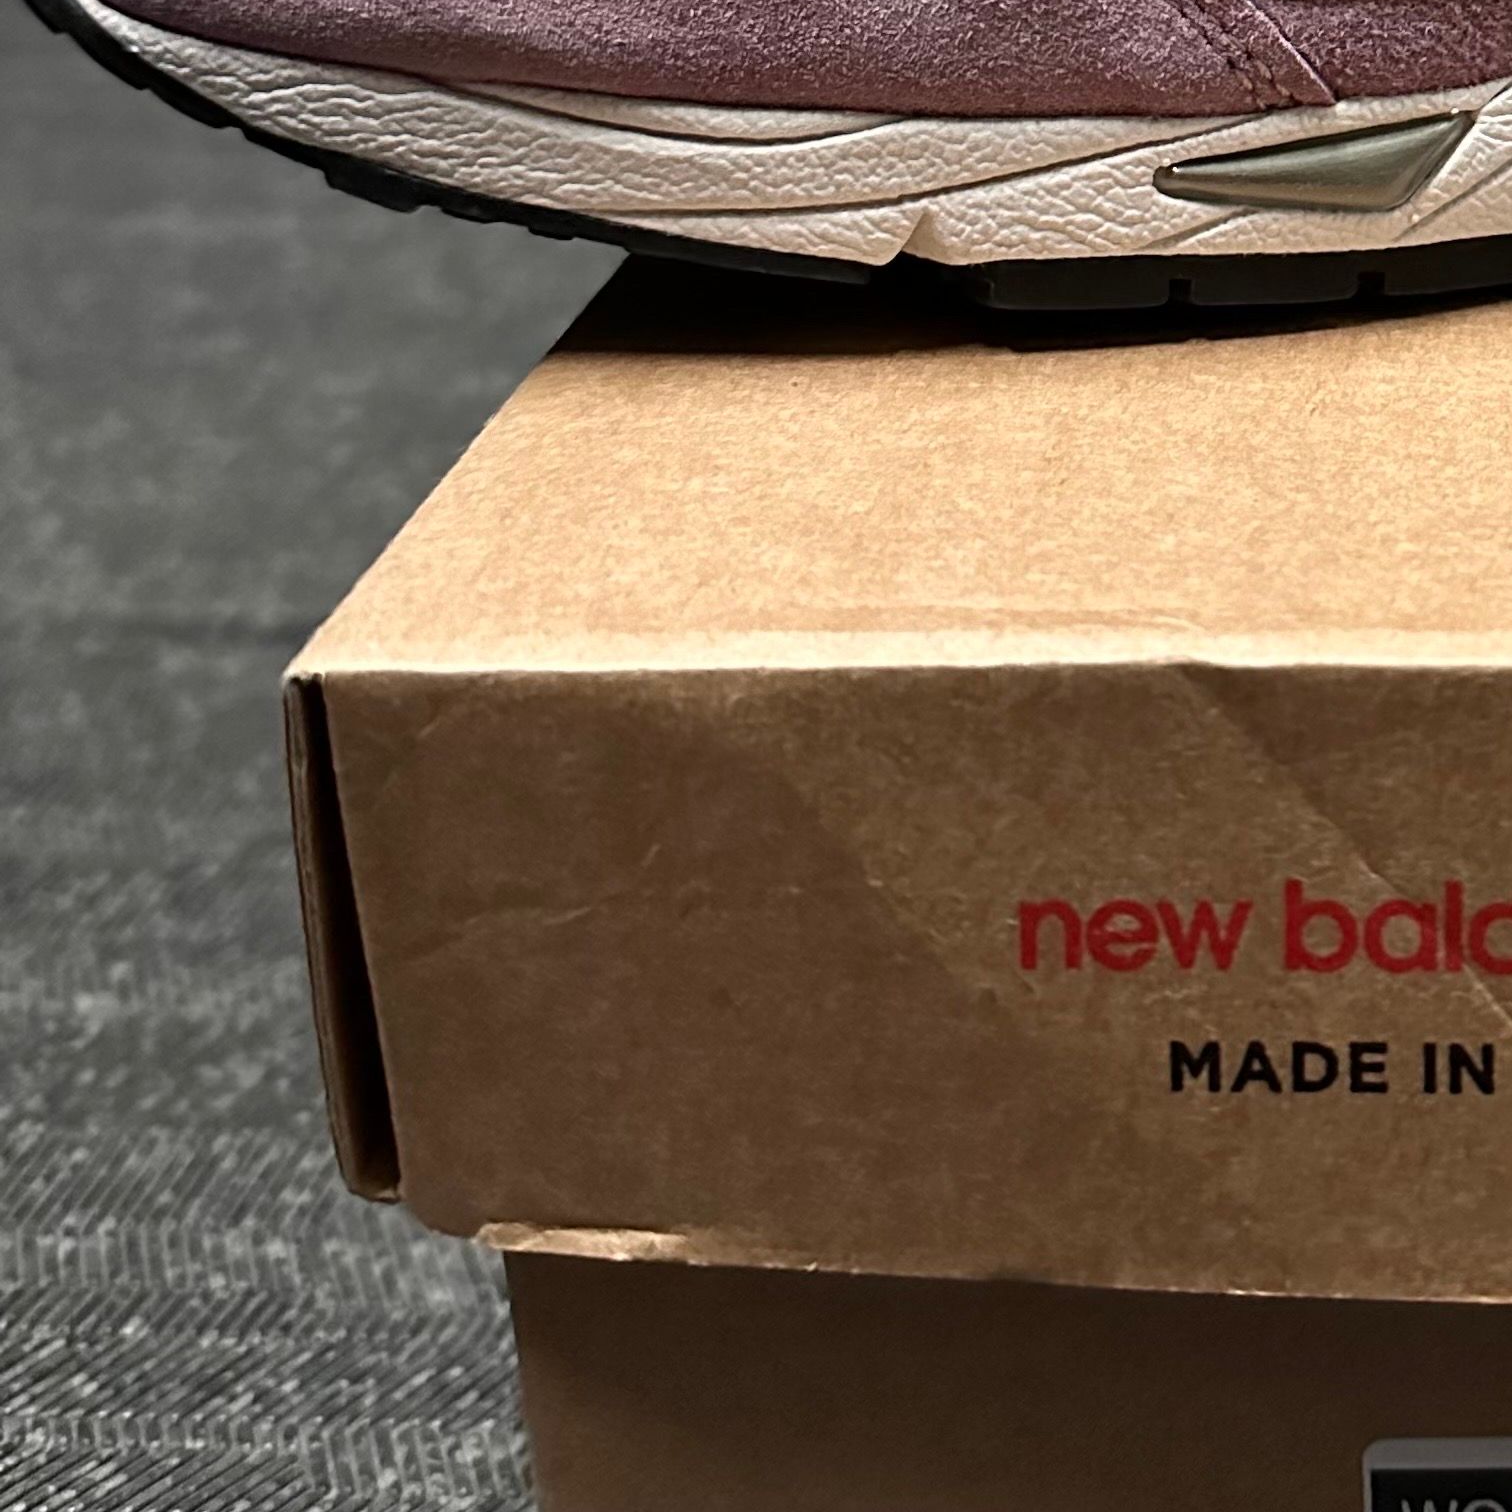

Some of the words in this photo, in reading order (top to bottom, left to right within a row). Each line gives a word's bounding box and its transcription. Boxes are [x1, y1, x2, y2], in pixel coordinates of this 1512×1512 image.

[1018, 898, 1253, 972] new
[1169, 1041, 1390, 1095] MADE
[1423, 1043, 1495, 1095] IN
